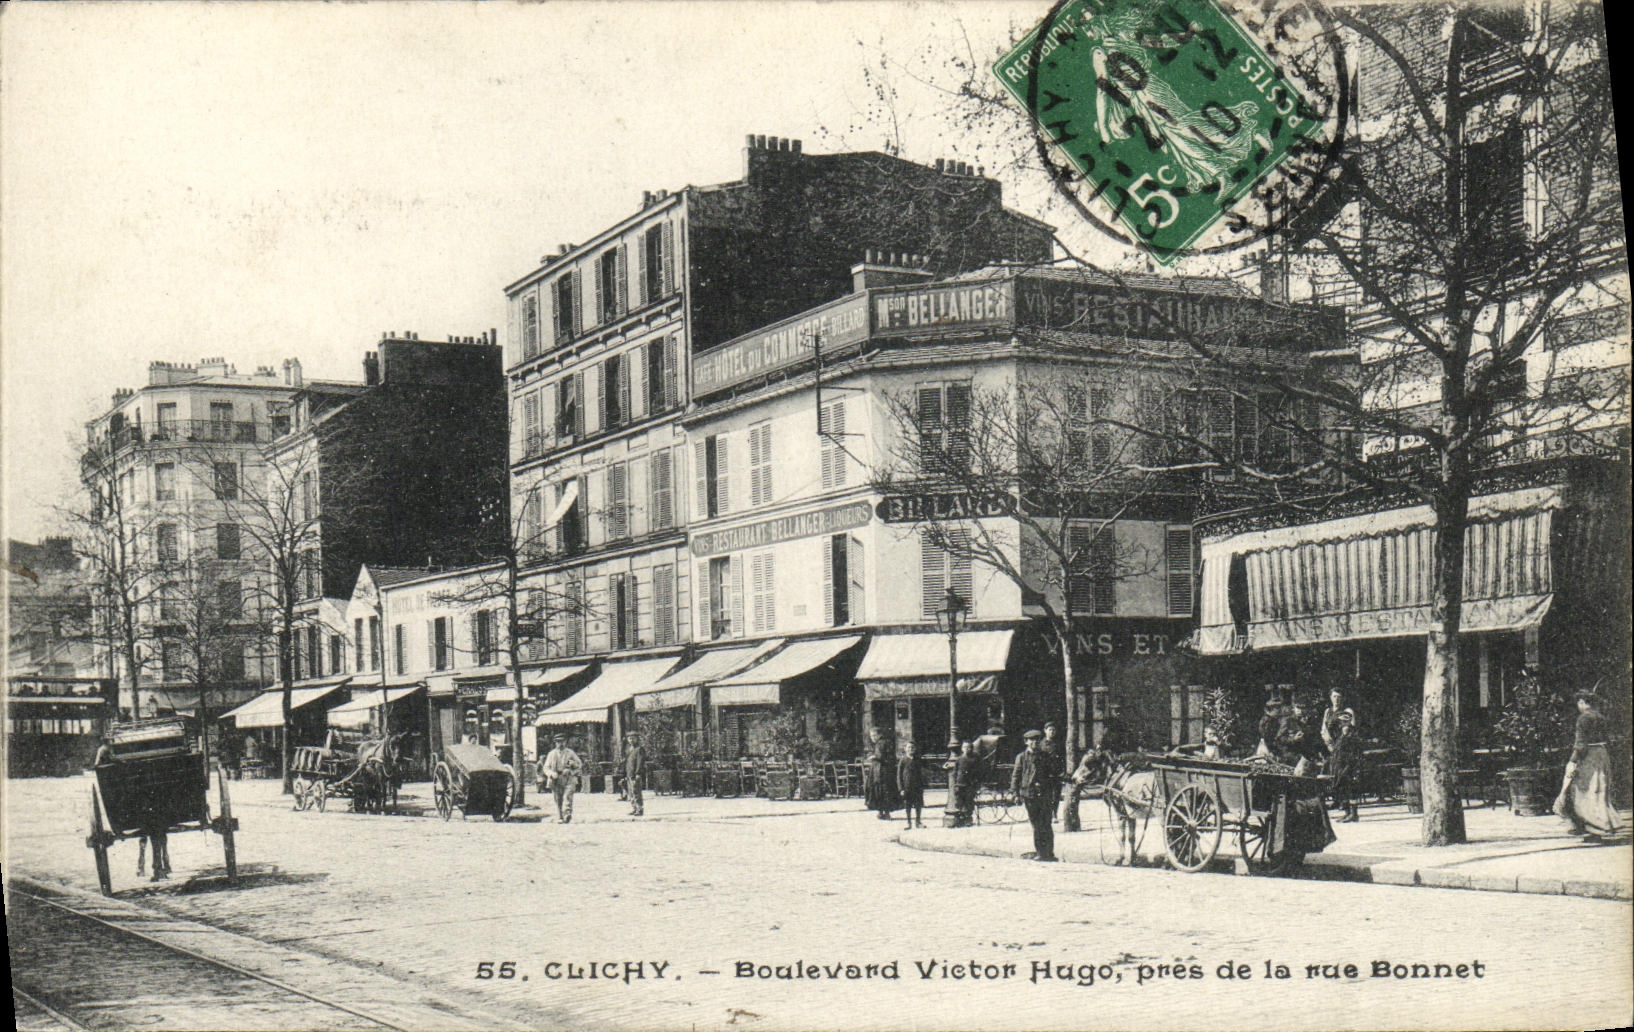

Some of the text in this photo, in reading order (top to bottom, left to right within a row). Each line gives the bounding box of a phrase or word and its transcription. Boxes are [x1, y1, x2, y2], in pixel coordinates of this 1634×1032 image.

[1005, 14, 1078, 83] REPBLIQUE
[713, 523, 767, 553] RESTAURANT
[771, 510, 827, 542] BELLANGER
[1041, 633, 1169, 655] VNS ET
